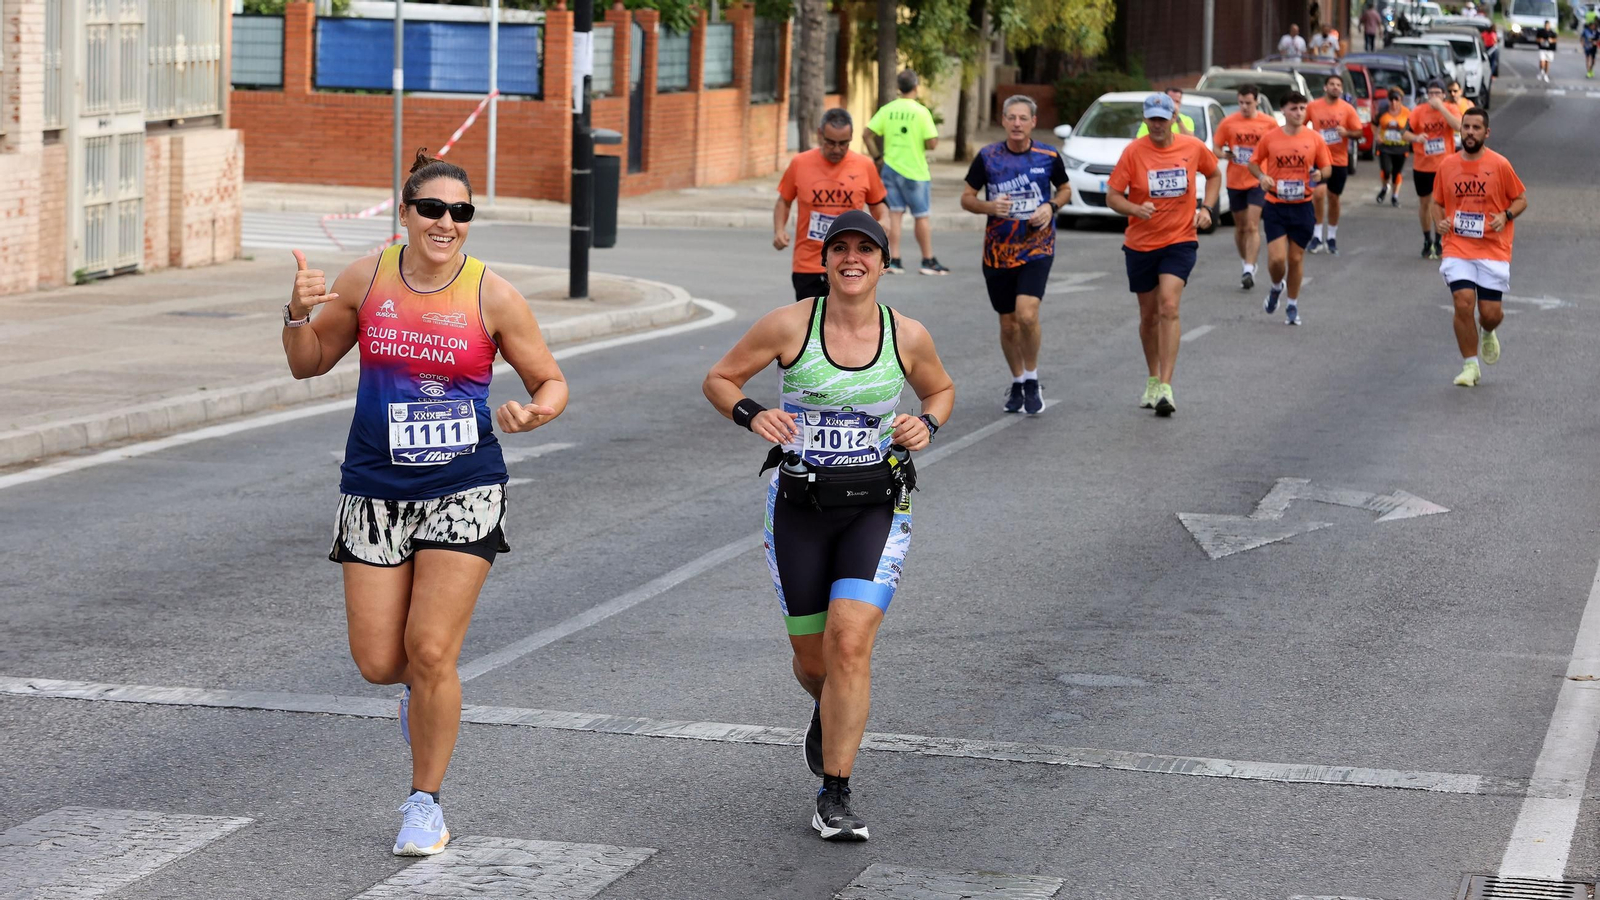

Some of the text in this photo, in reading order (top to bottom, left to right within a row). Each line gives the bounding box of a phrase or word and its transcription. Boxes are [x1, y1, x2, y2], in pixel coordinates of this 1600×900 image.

[1158, 178, 1178, 188] 925
[1454, 181, 1486, 194] XXIX
[812, 189, 853, 204] XXIX
[367, 326, 468, 351] CLUB TRIATLON
[370, 340, 456, 365] CHICLANA
[404, 421, 462, 446] 1111
[816, 428, 867, 449] 1012
[831, 452, 877, 465] MIZUNO
